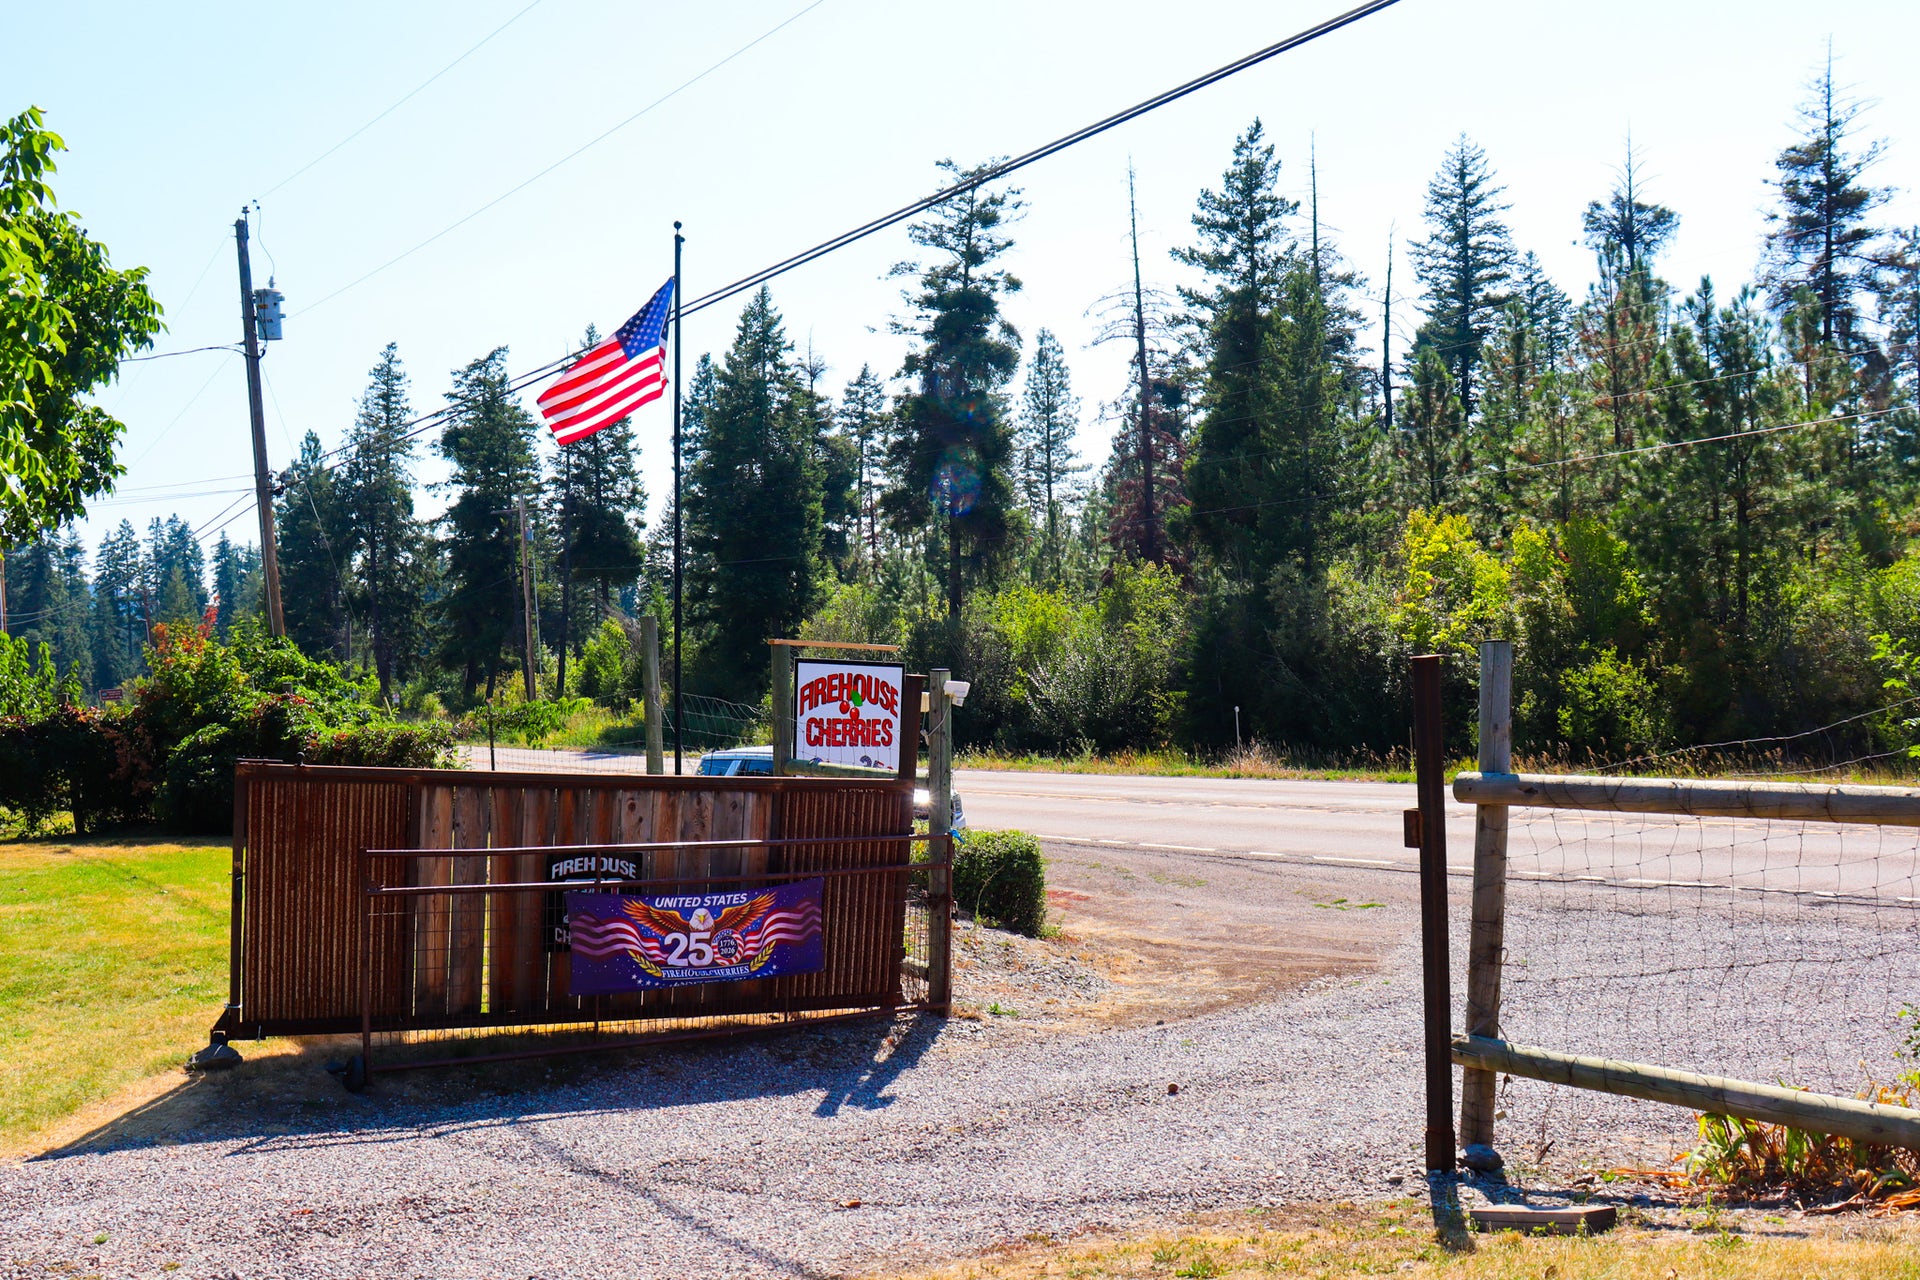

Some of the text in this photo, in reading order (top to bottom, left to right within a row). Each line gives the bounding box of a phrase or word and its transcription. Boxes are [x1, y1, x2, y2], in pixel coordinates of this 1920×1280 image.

[799, 672, 899, 719] FIREHOUSE
[806, 717, 893, 747] CHERRIES
[551, 857, 637, 880] FIREHOUSE
[654, 893, 748, 908] UNITED STATES
[720, 947, 736, 955] 2026
